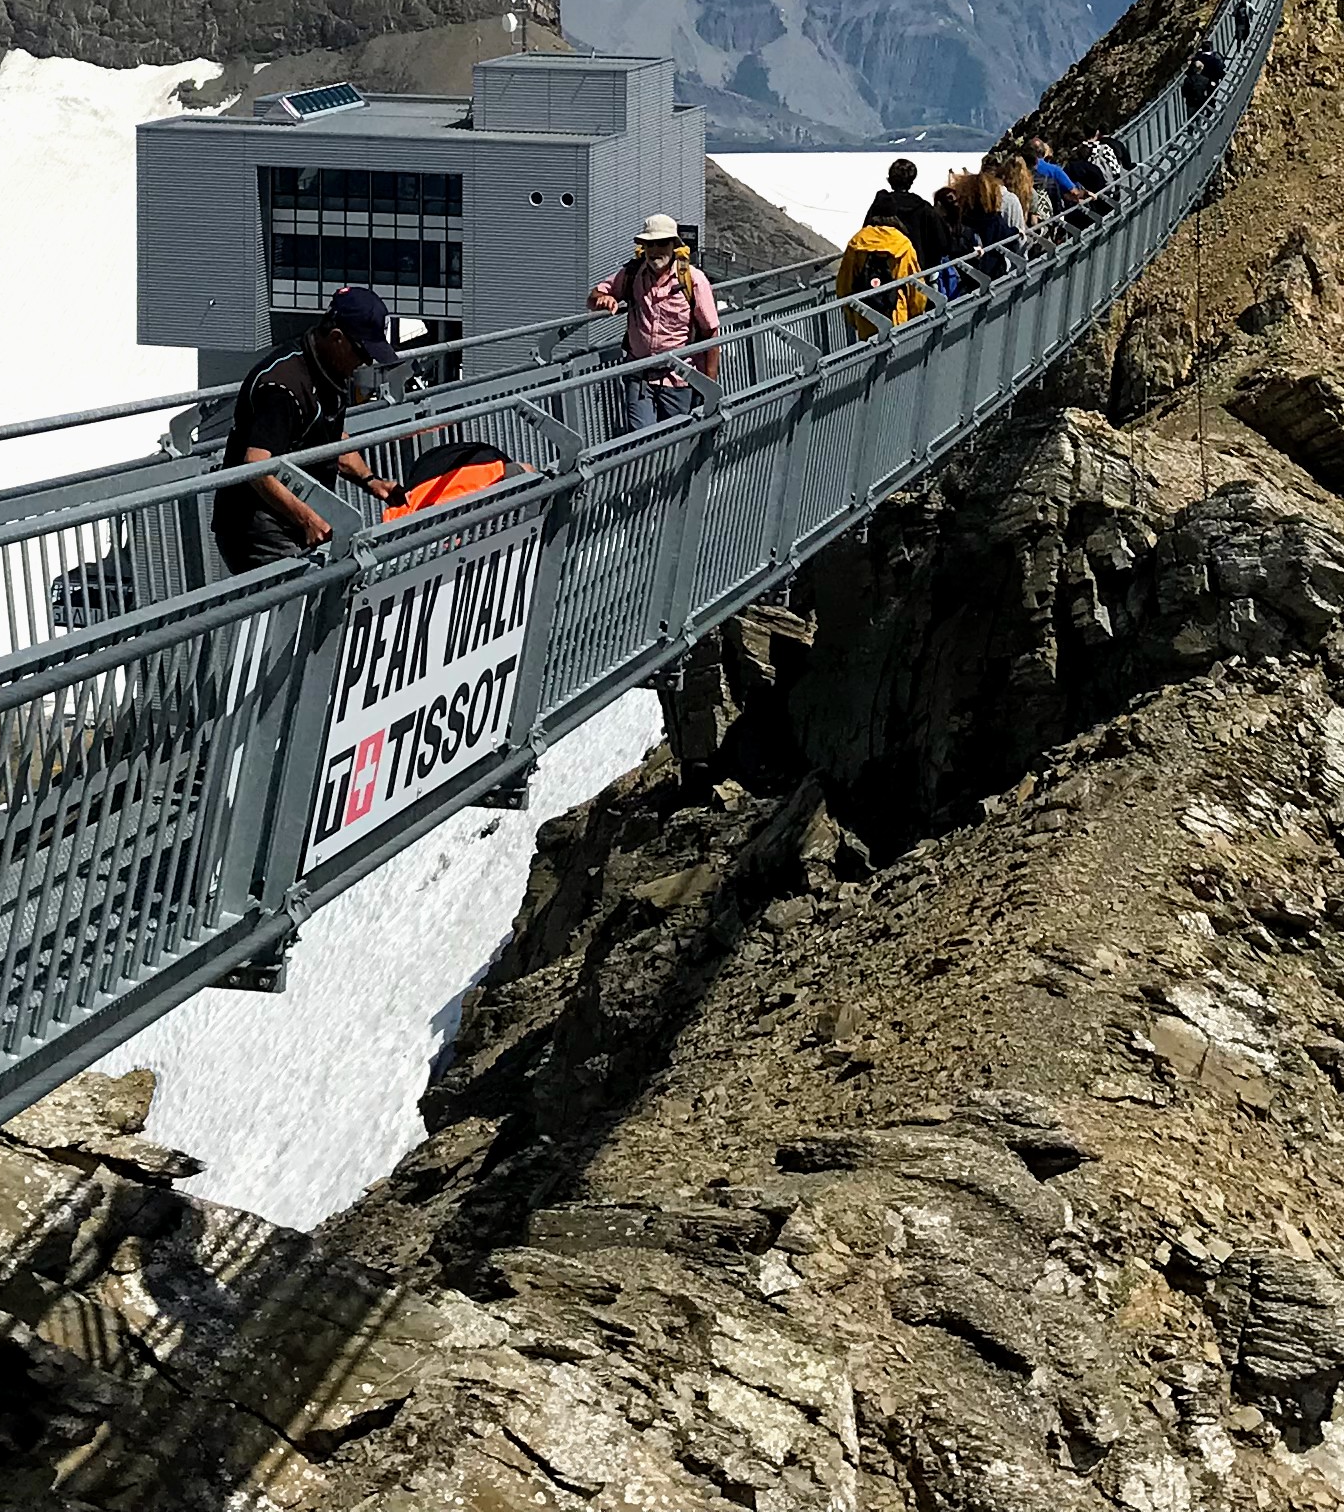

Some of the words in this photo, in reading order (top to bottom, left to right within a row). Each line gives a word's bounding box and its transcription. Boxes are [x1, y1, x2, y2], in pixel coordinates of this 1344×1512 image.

[337, 574, 443, 723] PEAK
[443, 533, 537, 667] WALK
[385, 654, 517, 802] TISSOT
